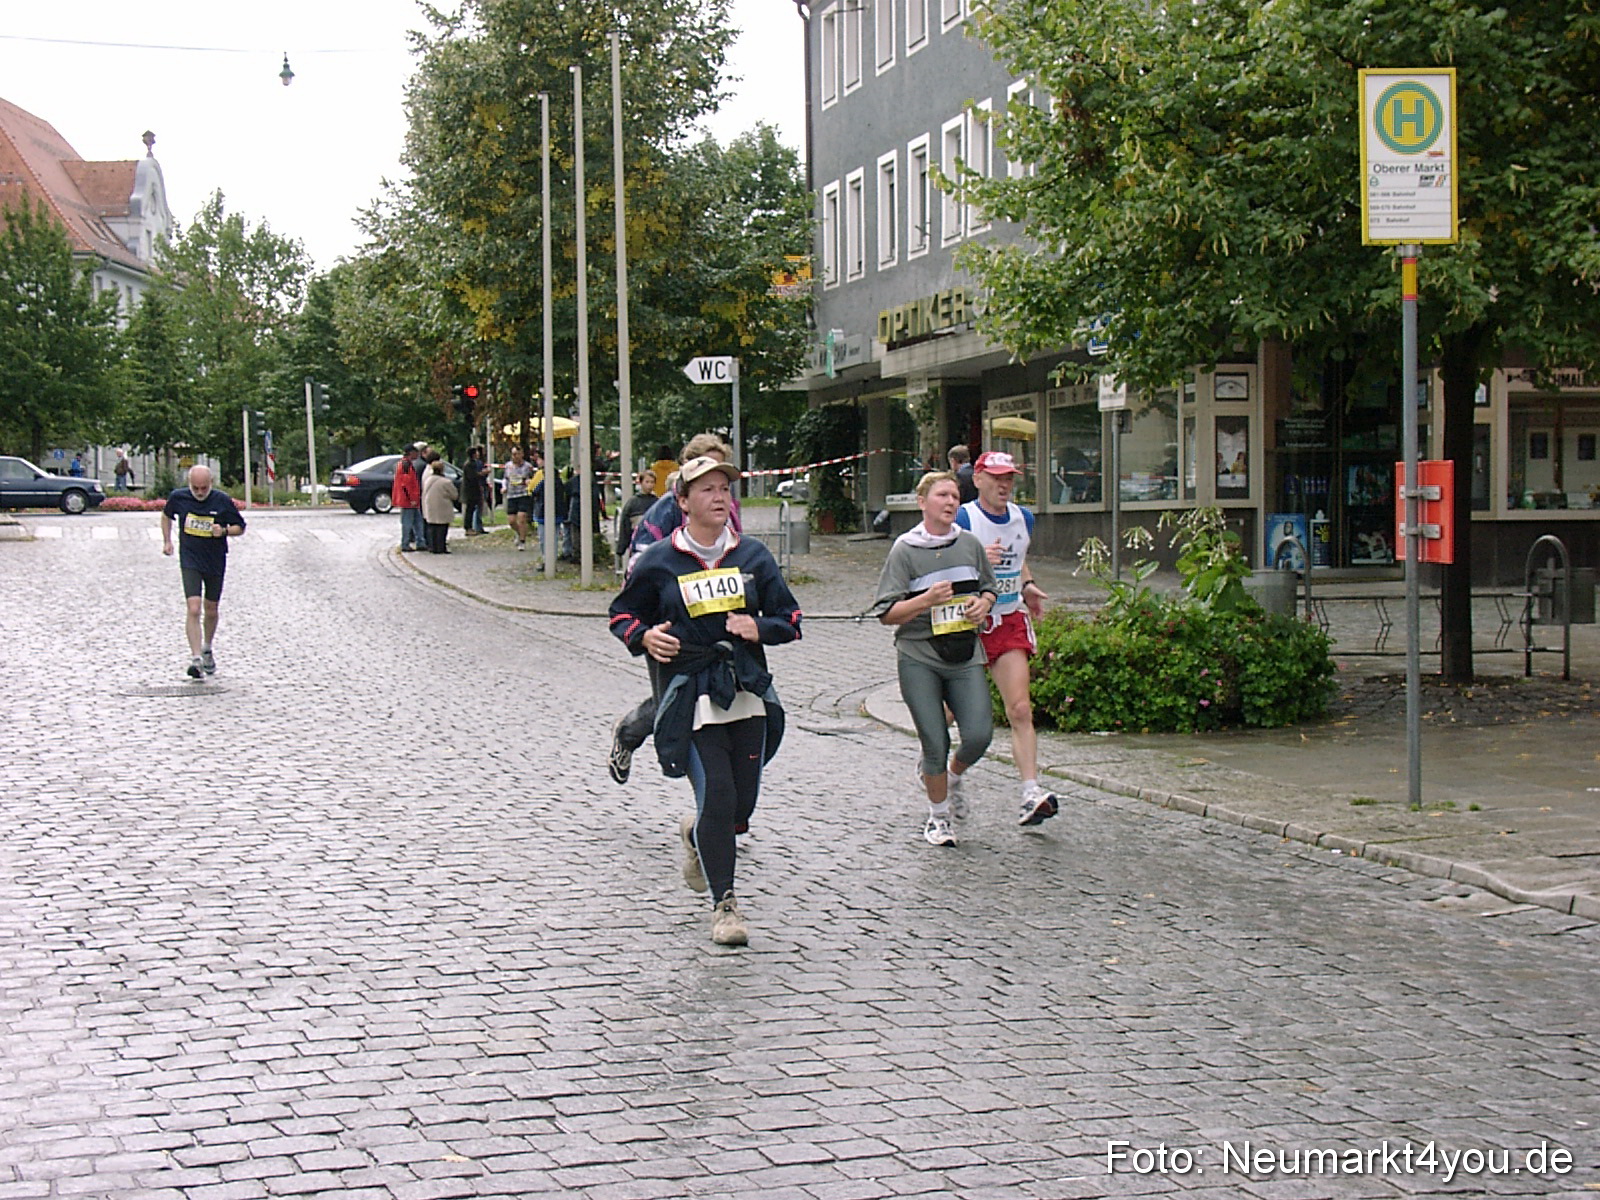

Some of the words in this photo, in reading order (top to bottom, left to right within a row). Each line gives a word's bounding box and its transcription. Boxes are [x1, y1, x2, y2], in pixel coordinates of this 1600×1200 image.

[1373, 163, 1410, 174] Oberer
[1414, 163, 1445, 173] Markt
[878, 285, 970, 343] OPTIKER
[698, 360, 726, 380] WC
[693, 576, 739, 599] 1140
